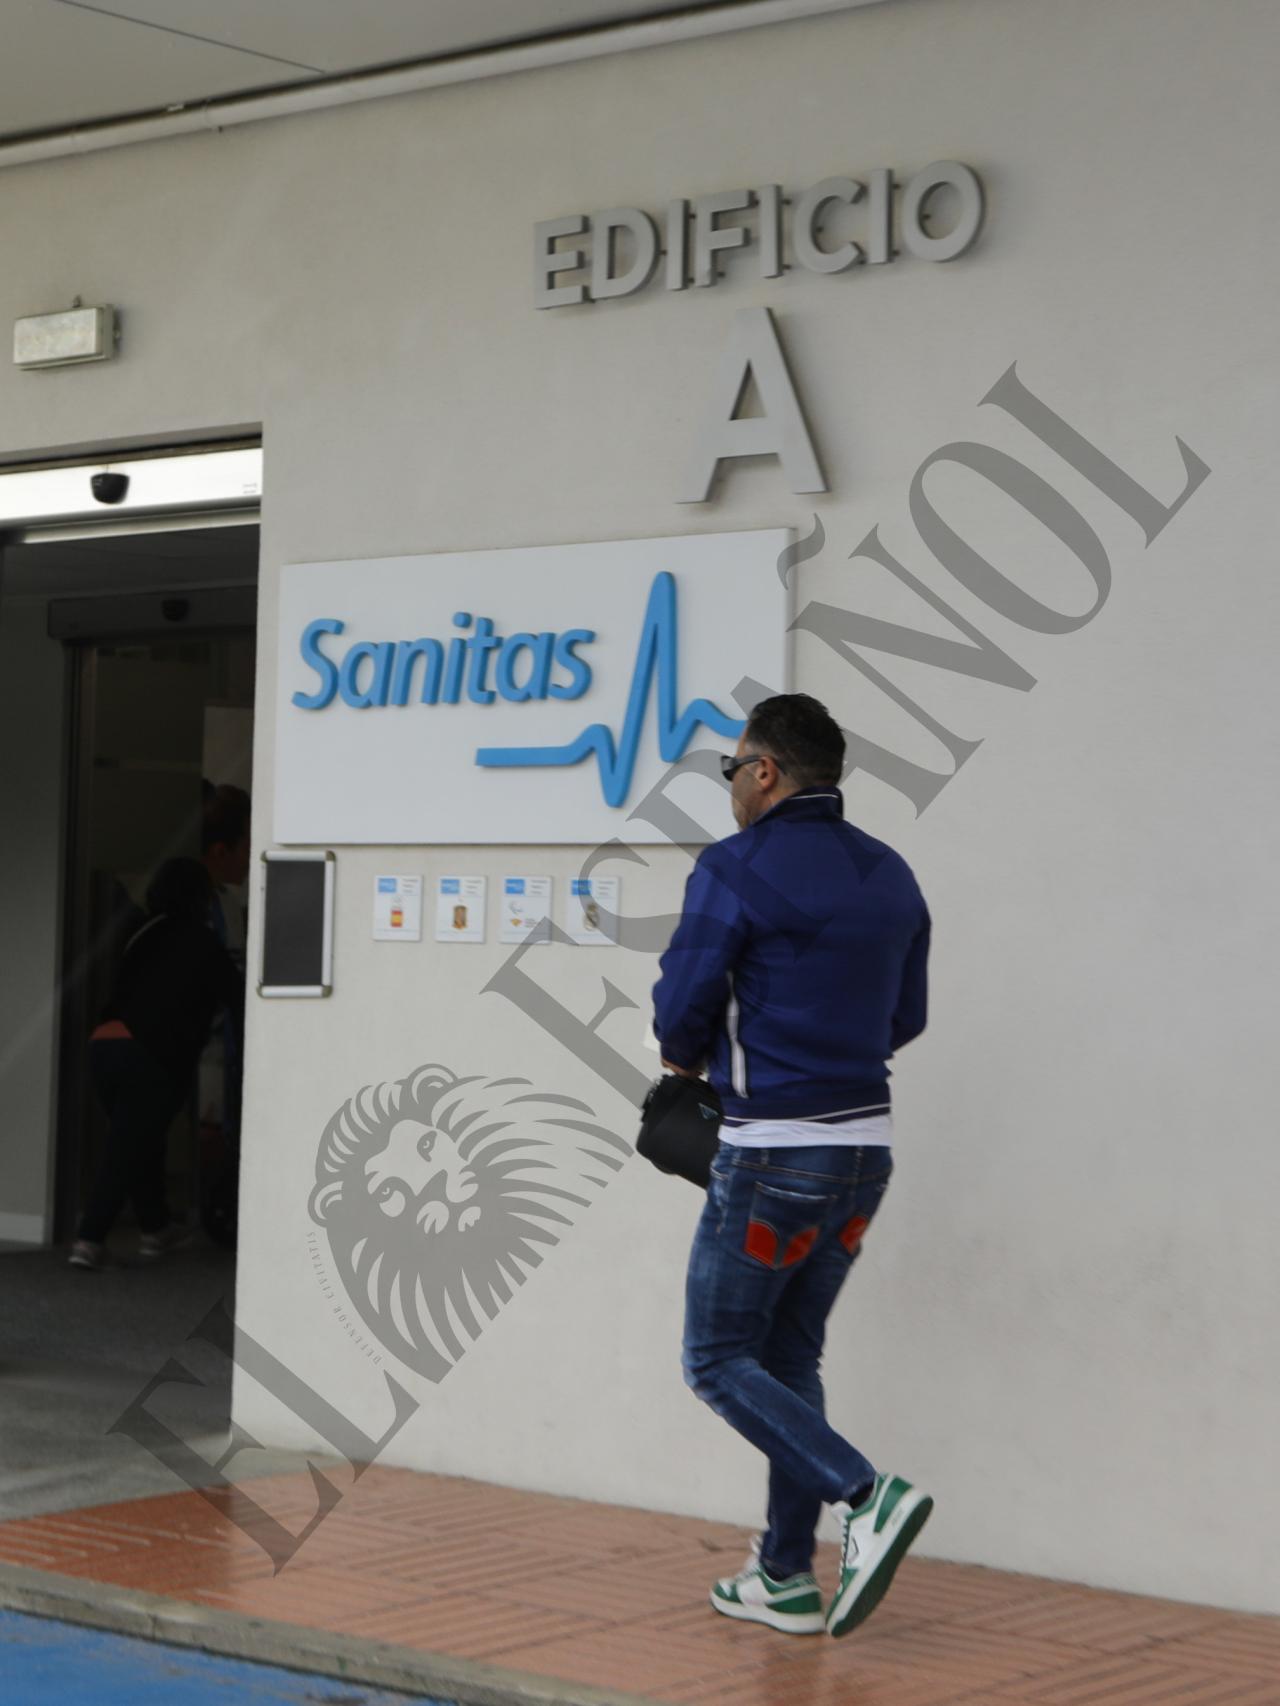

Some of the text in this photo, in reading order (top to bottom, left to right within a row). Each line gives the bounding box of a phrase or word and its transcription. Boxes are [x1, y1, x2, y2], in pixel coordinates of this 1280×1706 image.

[533, 160, 986, 311] EDIFICIO
[675, 306, 831, 504] A
[292, 611, 597, 712] Sanitas
